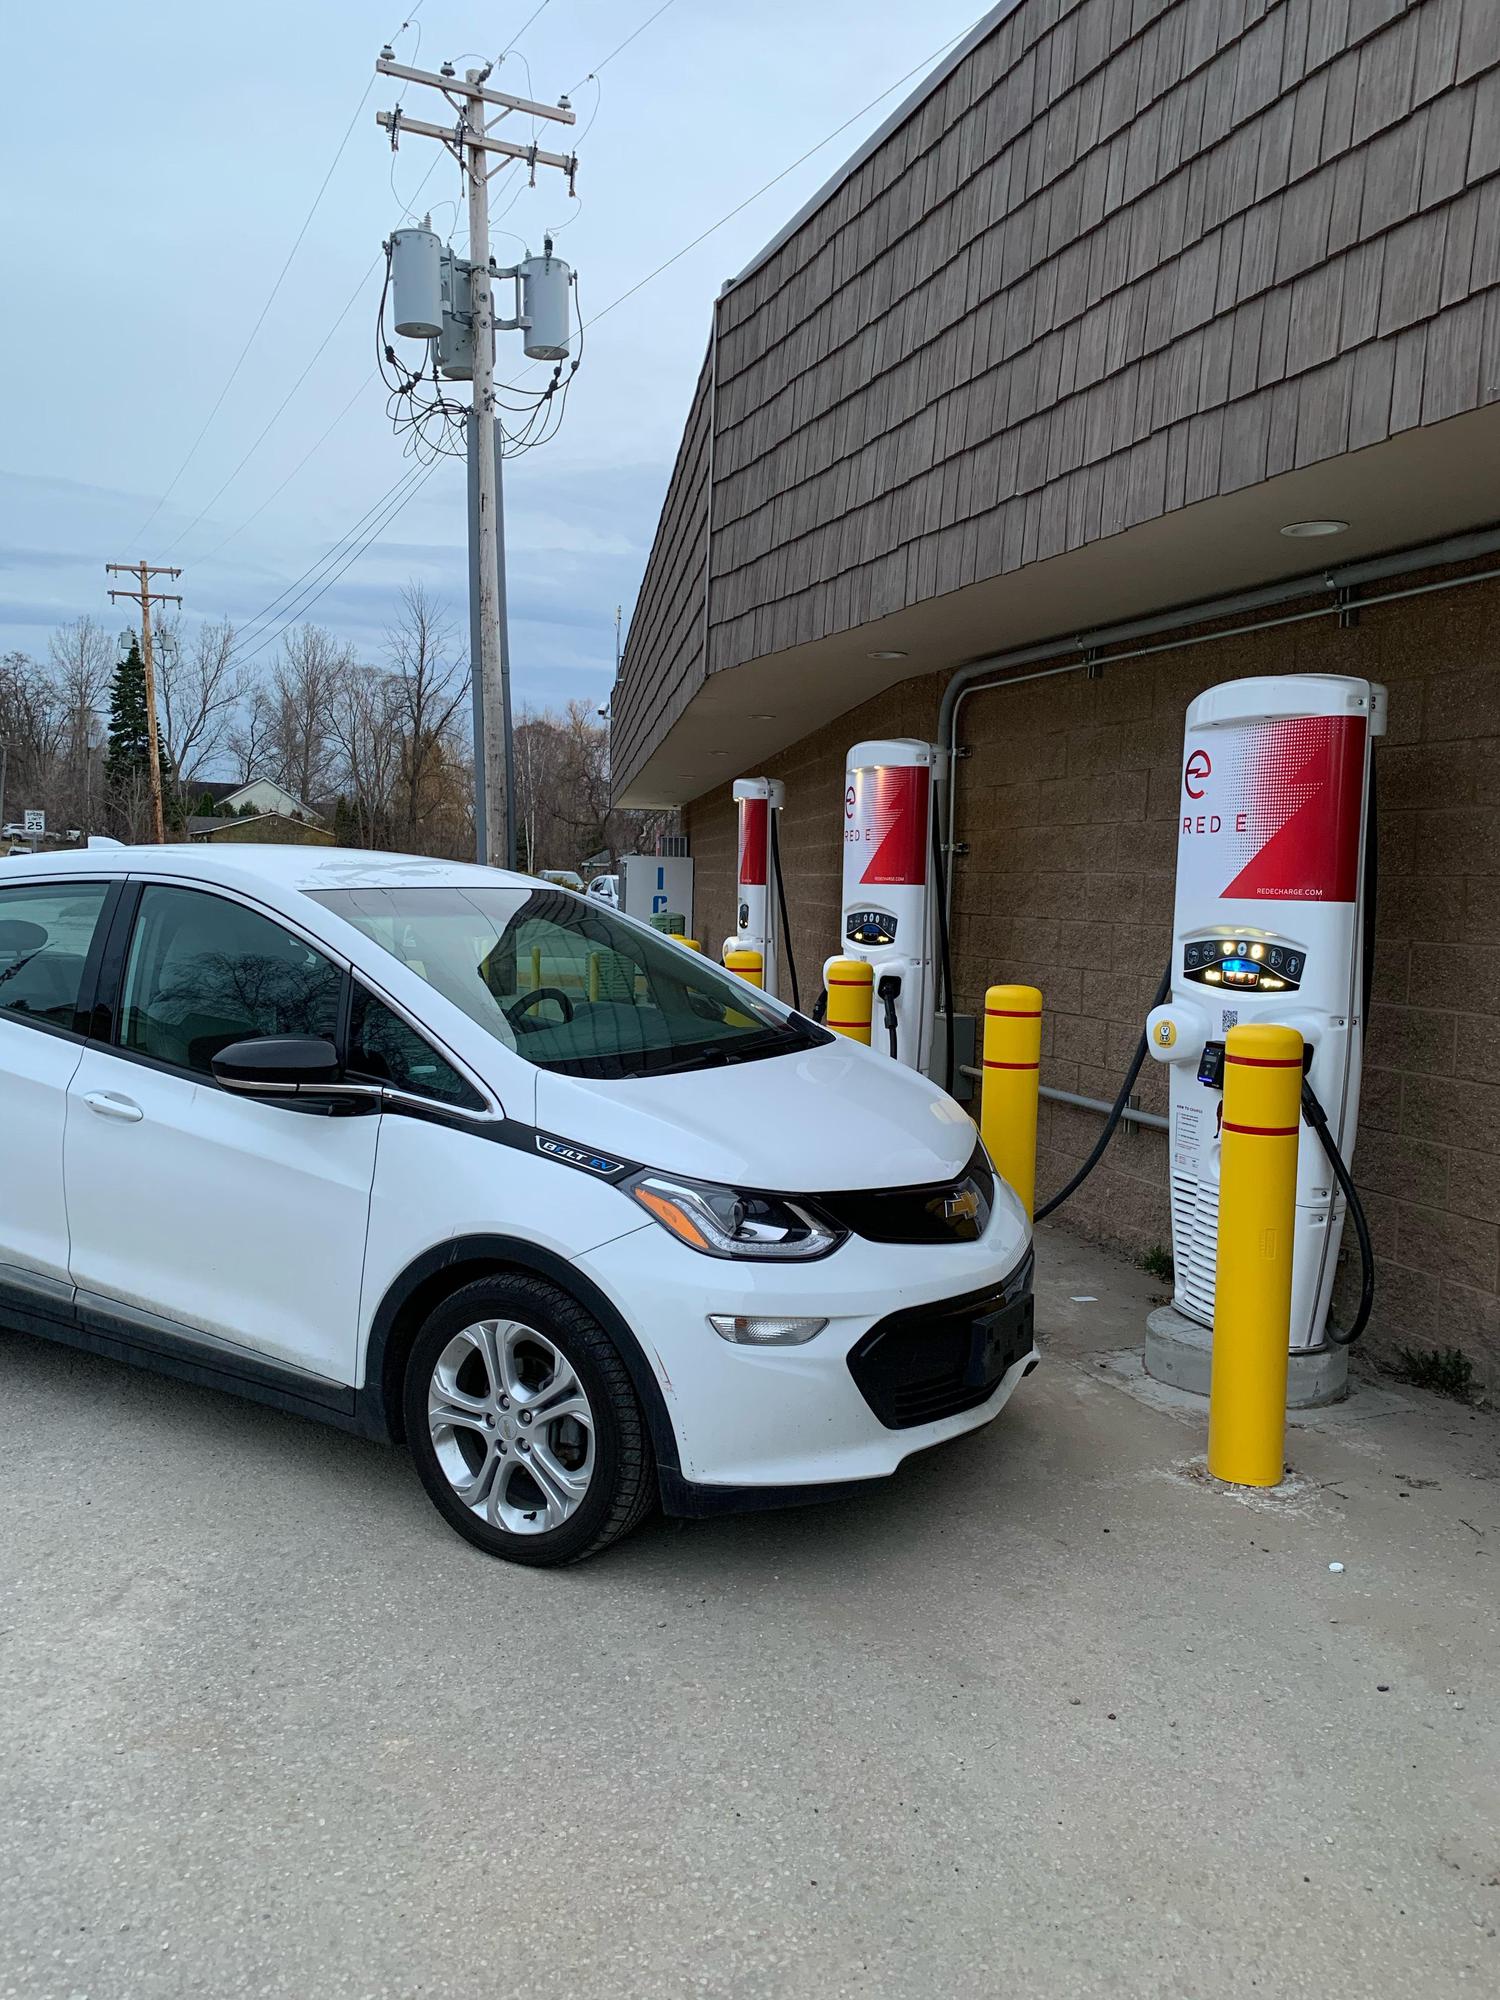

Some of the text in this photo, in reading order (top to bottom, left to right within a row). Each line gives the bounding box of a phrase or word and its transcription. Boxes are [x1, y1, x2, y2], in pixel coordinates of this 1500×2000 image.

[27, 821, 43, 831] 25
[1182, 813, 1247, 835] RED E
[844, 829, 872, 842] RED E
[1256, 887, 1323, 896] REDECHARGE.COM
